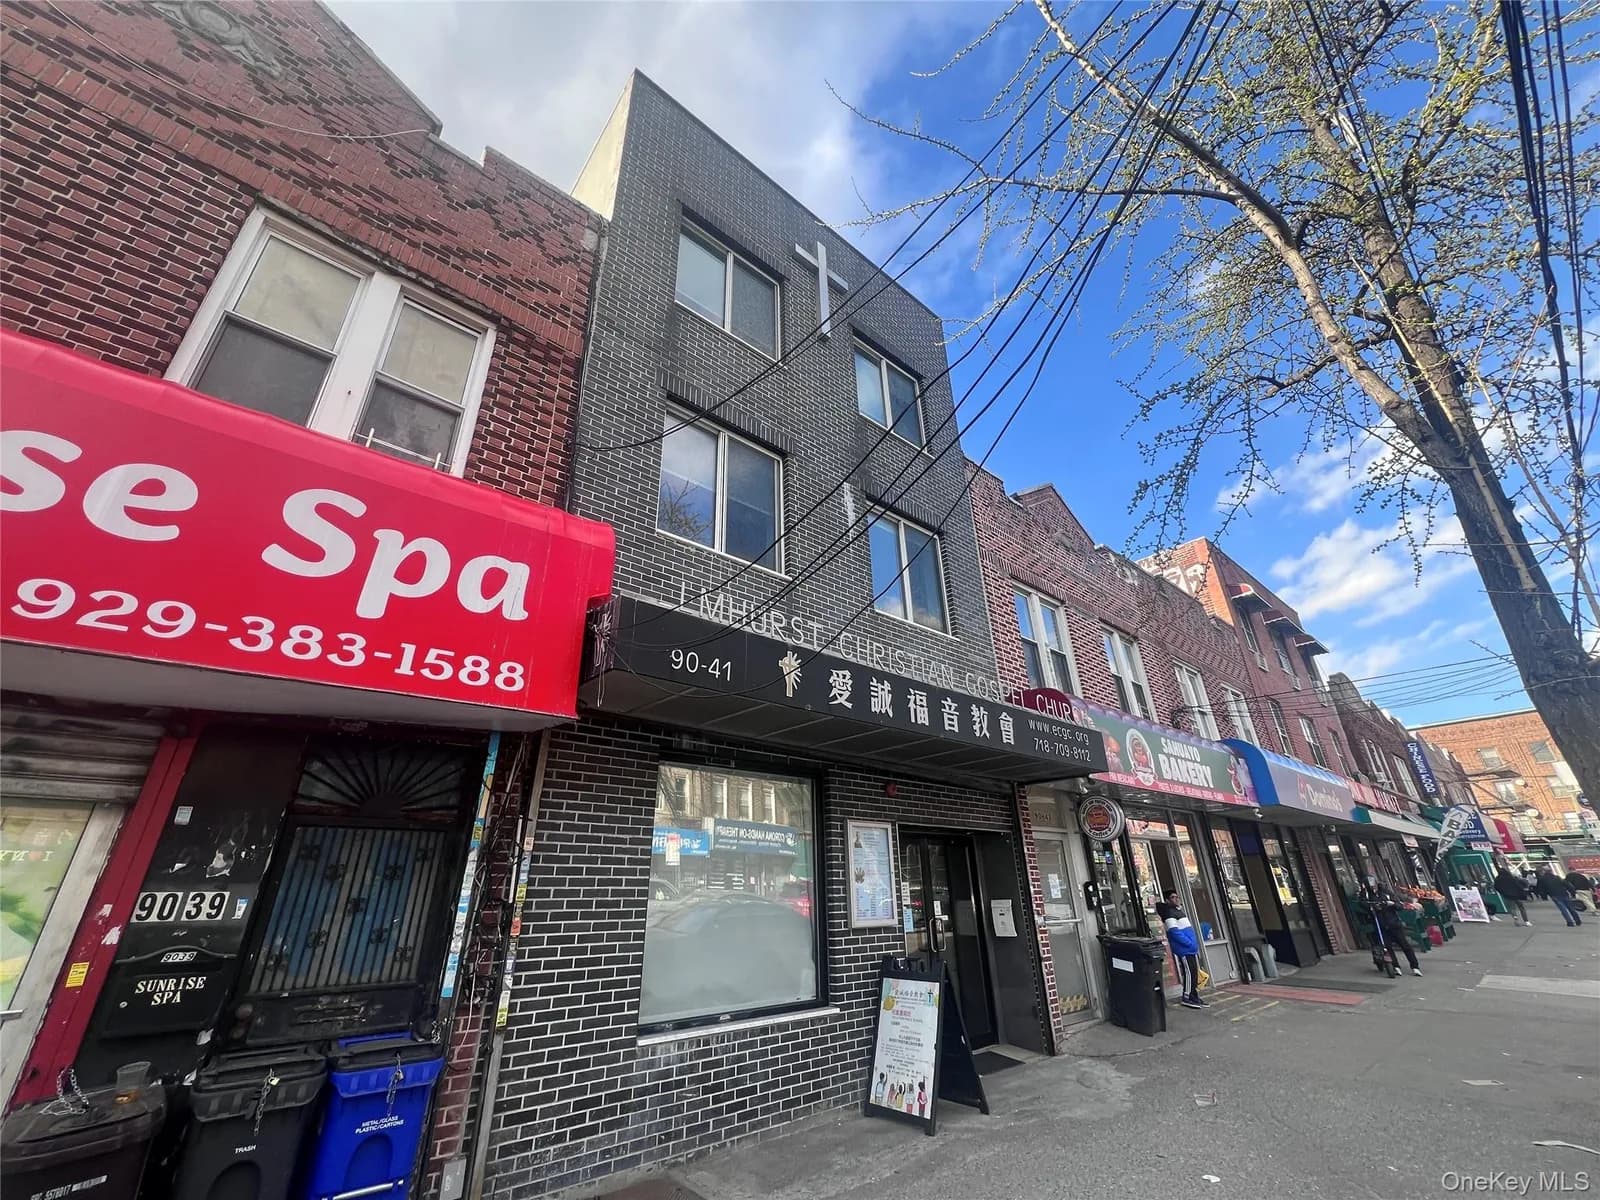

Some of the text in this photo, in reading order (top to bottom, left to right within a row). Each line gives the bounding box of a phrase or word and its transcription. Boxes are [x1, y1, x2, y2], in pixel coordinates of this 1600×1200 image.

[262, 489, 529, 620] Spa
[10, 578, 525, 692] 929-383-1588
[671, 649, 731, 682] 90-41
[840, 632, 954, 690] CHRISTIAN
[965, 672, 1028, 709] GOSPEL
[828, 668, 1015, 745] 愛誠福音教會
[1027, 718, 1089, 746] www.ecgc.org
[1033, 737, 1092, 762] 718-709-8112
[1158, 753, 1215, 788] BAKERY
[135, 892, 225, 922] 9039
[163, 952, 196, 962] 9039
[134, 976, 207, 994] SUNRISE
[150, 990, 182, 1006] SPA
[234, 1144, 257, 1154] TRASH
